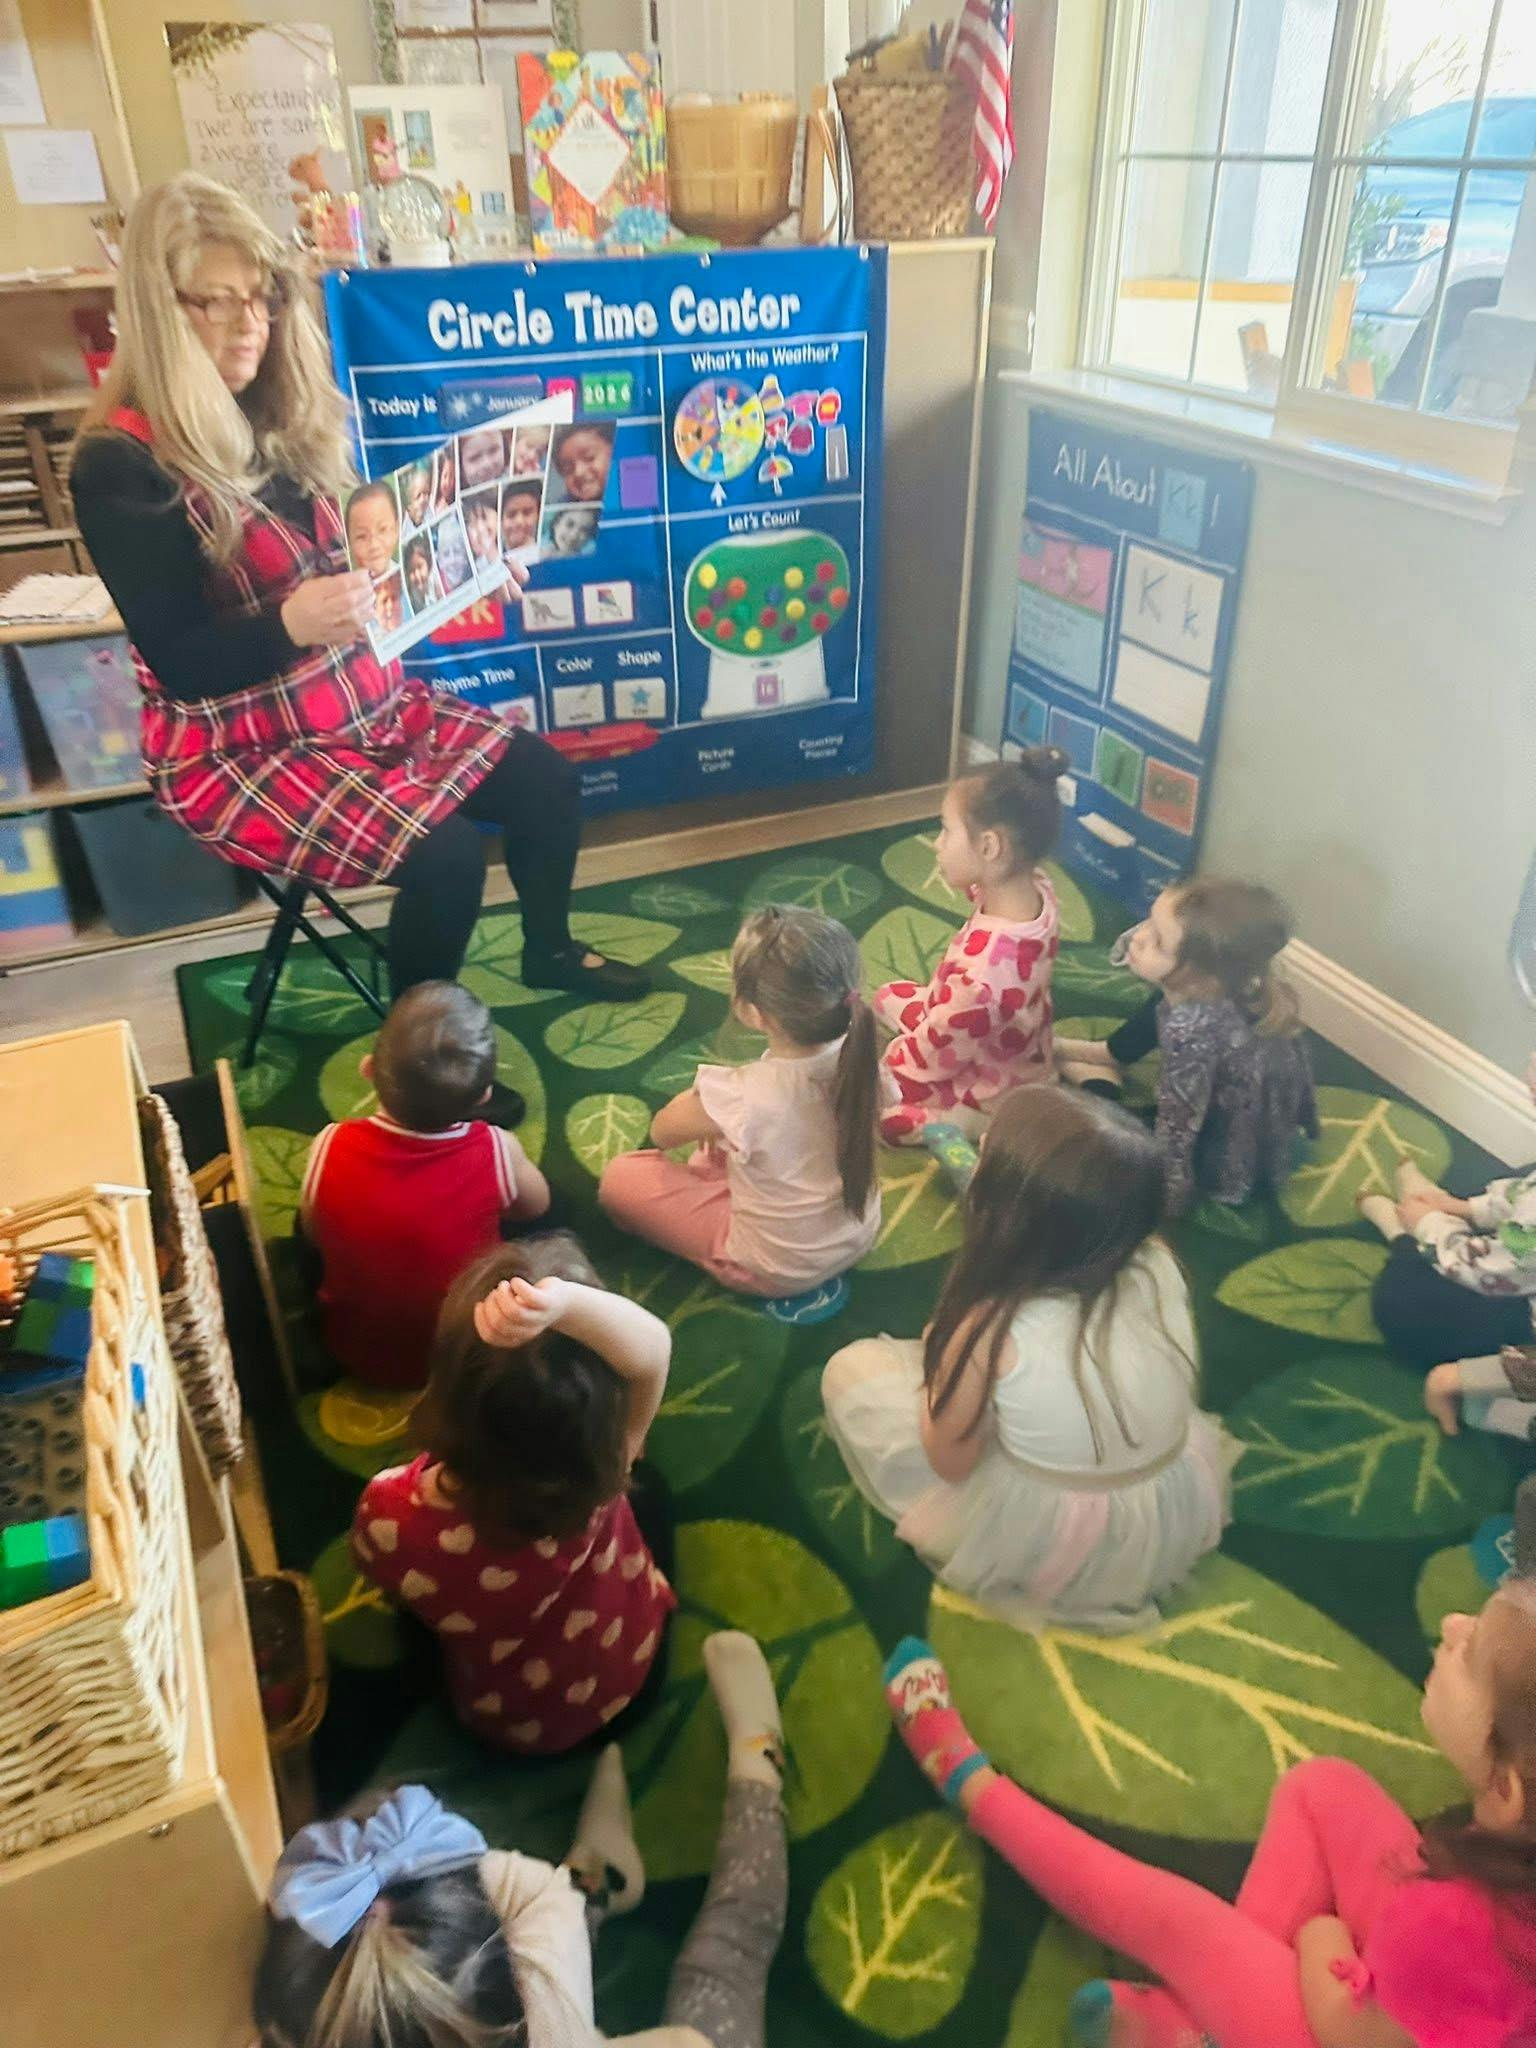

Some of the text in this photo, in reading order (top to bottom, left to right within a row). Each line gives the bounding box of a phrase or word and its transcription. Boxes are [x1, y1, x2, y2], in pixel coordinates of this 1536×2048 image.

[428, 284, 801, 351] Circle Time Center
[690, 342, 839, 373] What's the Weather?
[367, 394, 437, 418] Today is
[1054, 443, 1087, 484] All
[728, 508, 801, 532] Let's Count
[556, 656, 593, 674] Color
[617, 649, 662, 668] Shape
[483, 667, 517, 685] Time
